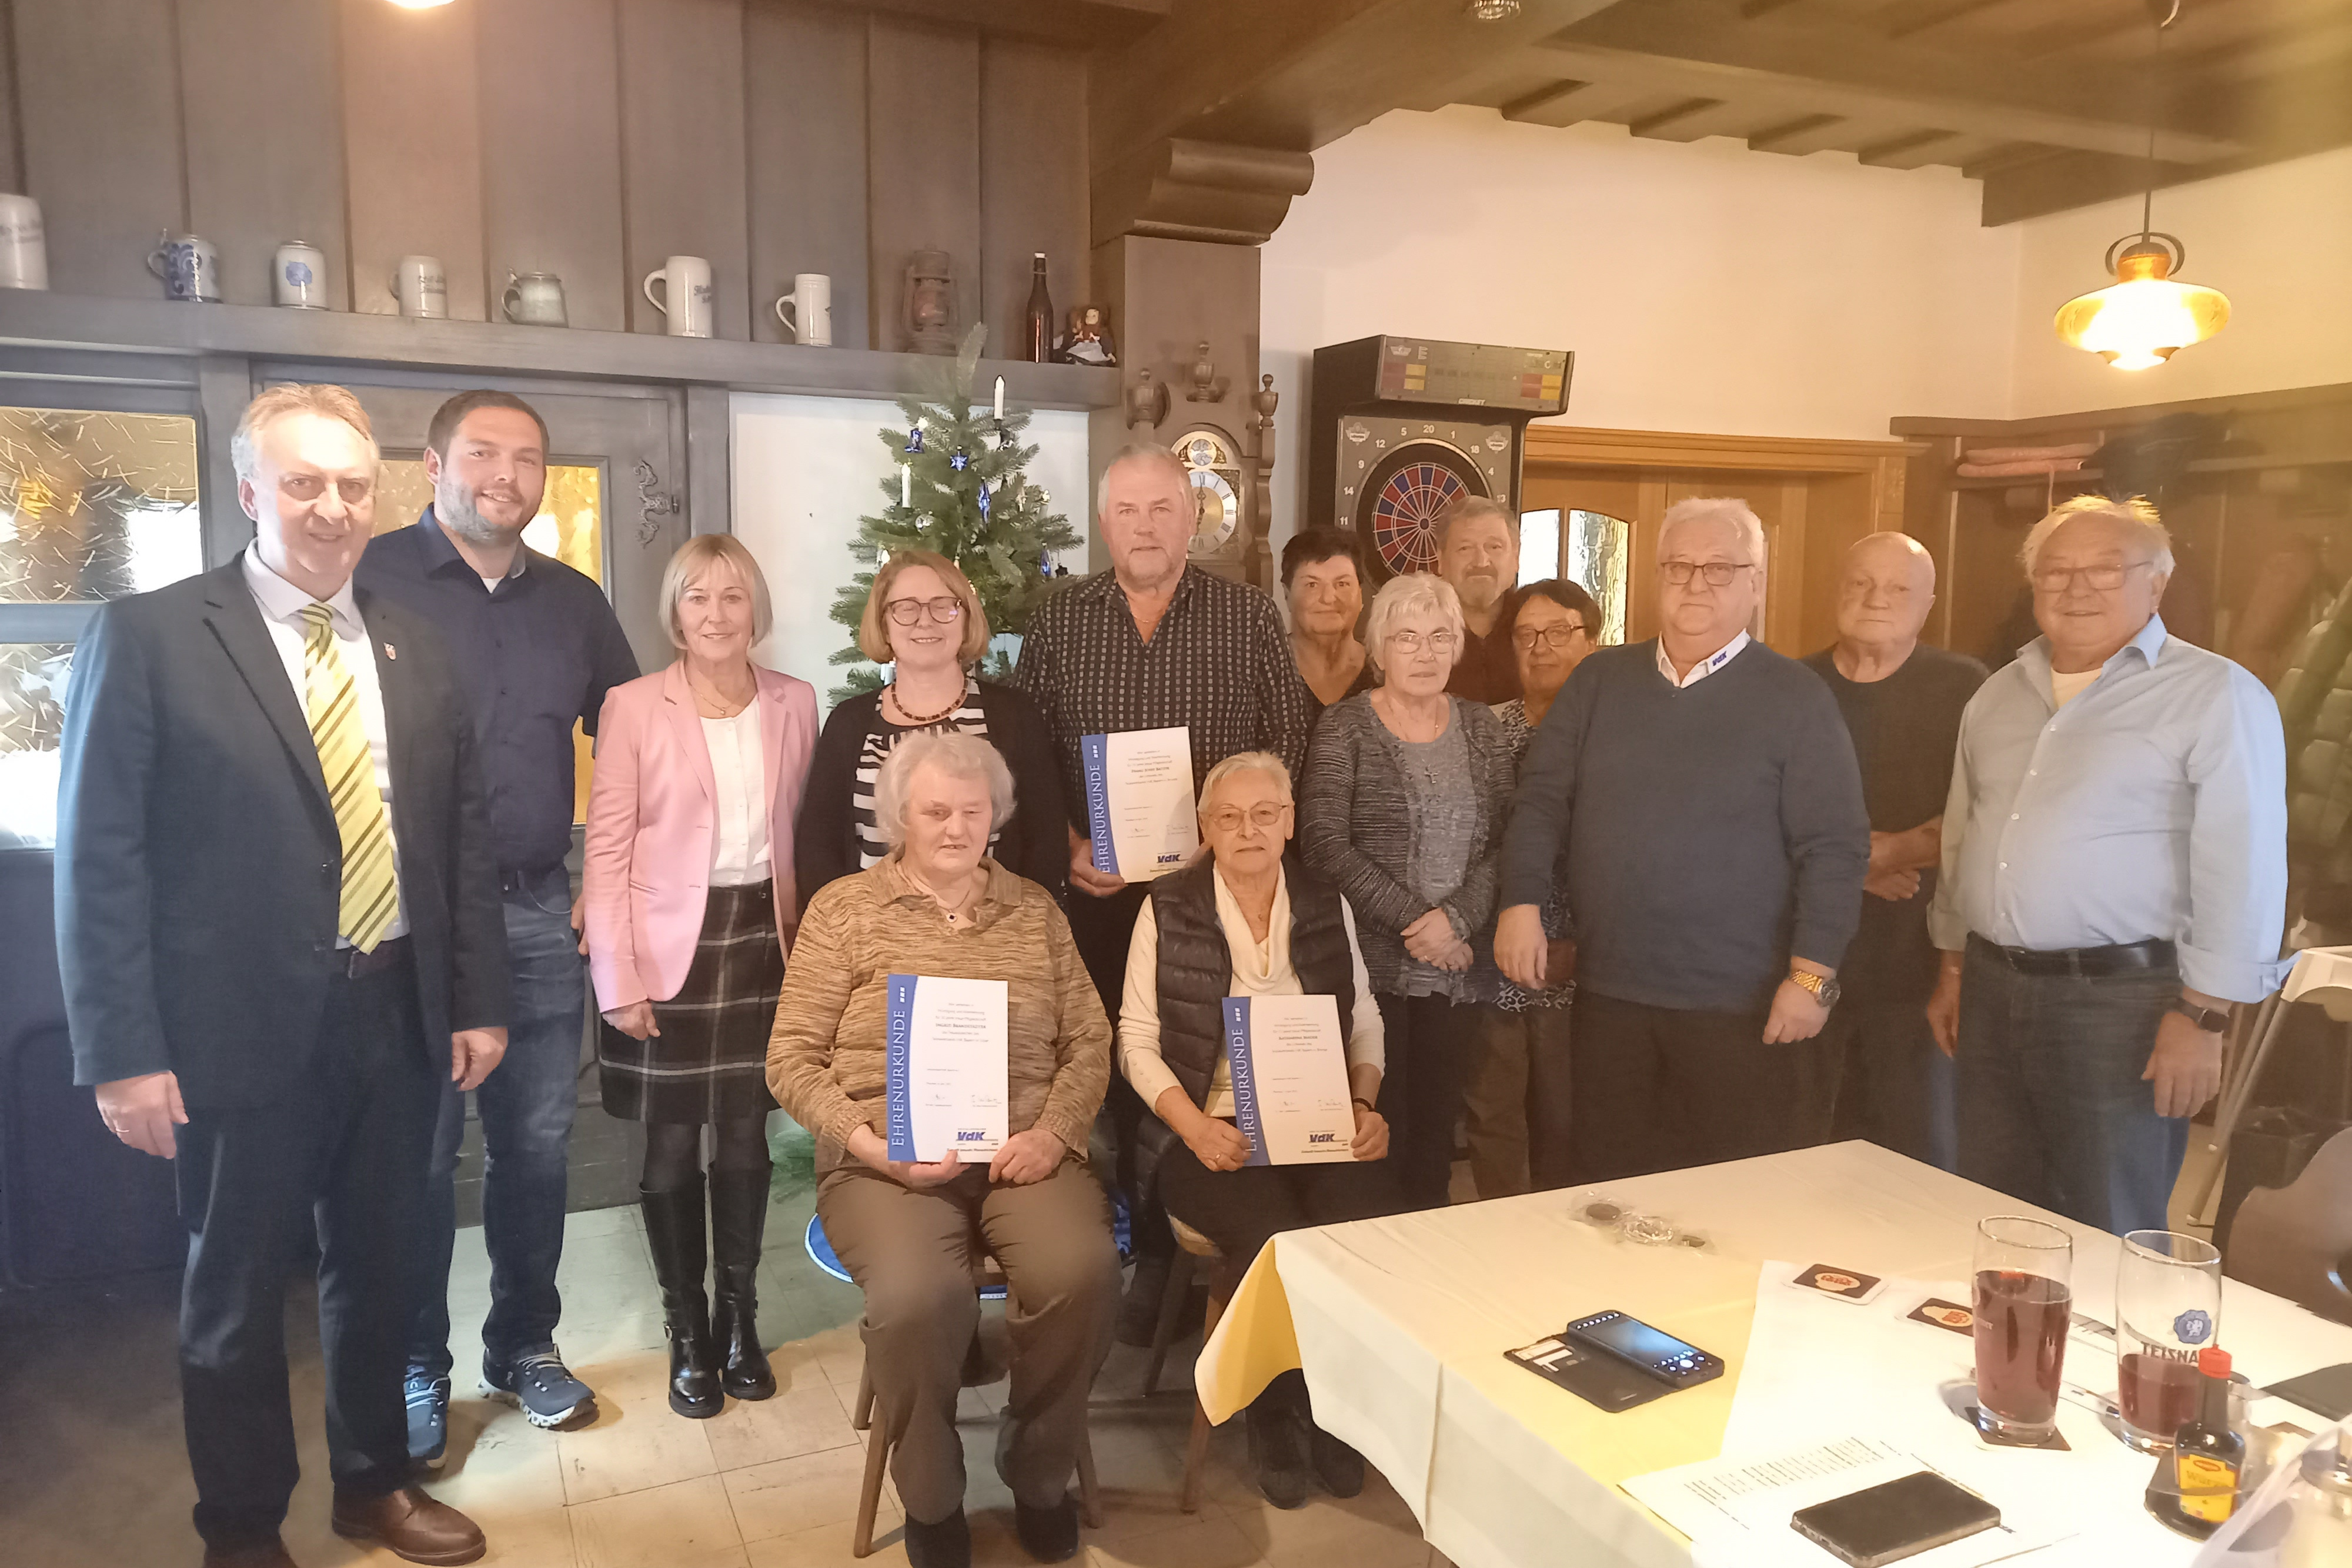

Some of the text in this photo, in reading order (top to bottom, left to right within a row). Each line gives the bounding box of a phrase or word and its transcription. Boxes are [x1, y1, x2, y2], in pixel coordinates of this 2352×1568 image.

[1401, 427, 1407, 436] 5
[1423, 424, 1435, 433] 20
[1451, 430, 1455, 439] 1
[1375, 439, 1386, 448] 12
[1470, 445, 1480, 454] 18
[1358, 460, 1365, 469] 9
[1488, 467, 1494, 476] 4
[1344, 486, 1354, 495] 14
[1496, 494, 1506, 503] 13
[1339, 516, 1348, 525] 11
[1090, 764, 1110, 872] EHRENURKUNDE
[1158, 854, 1181, 862] VdK
[891, 1011, 906, 1146] EHRENURKUNDE
[958, 1132, 985, 1141] VdK
[1309, 1134, 1335, 1142] VdK
